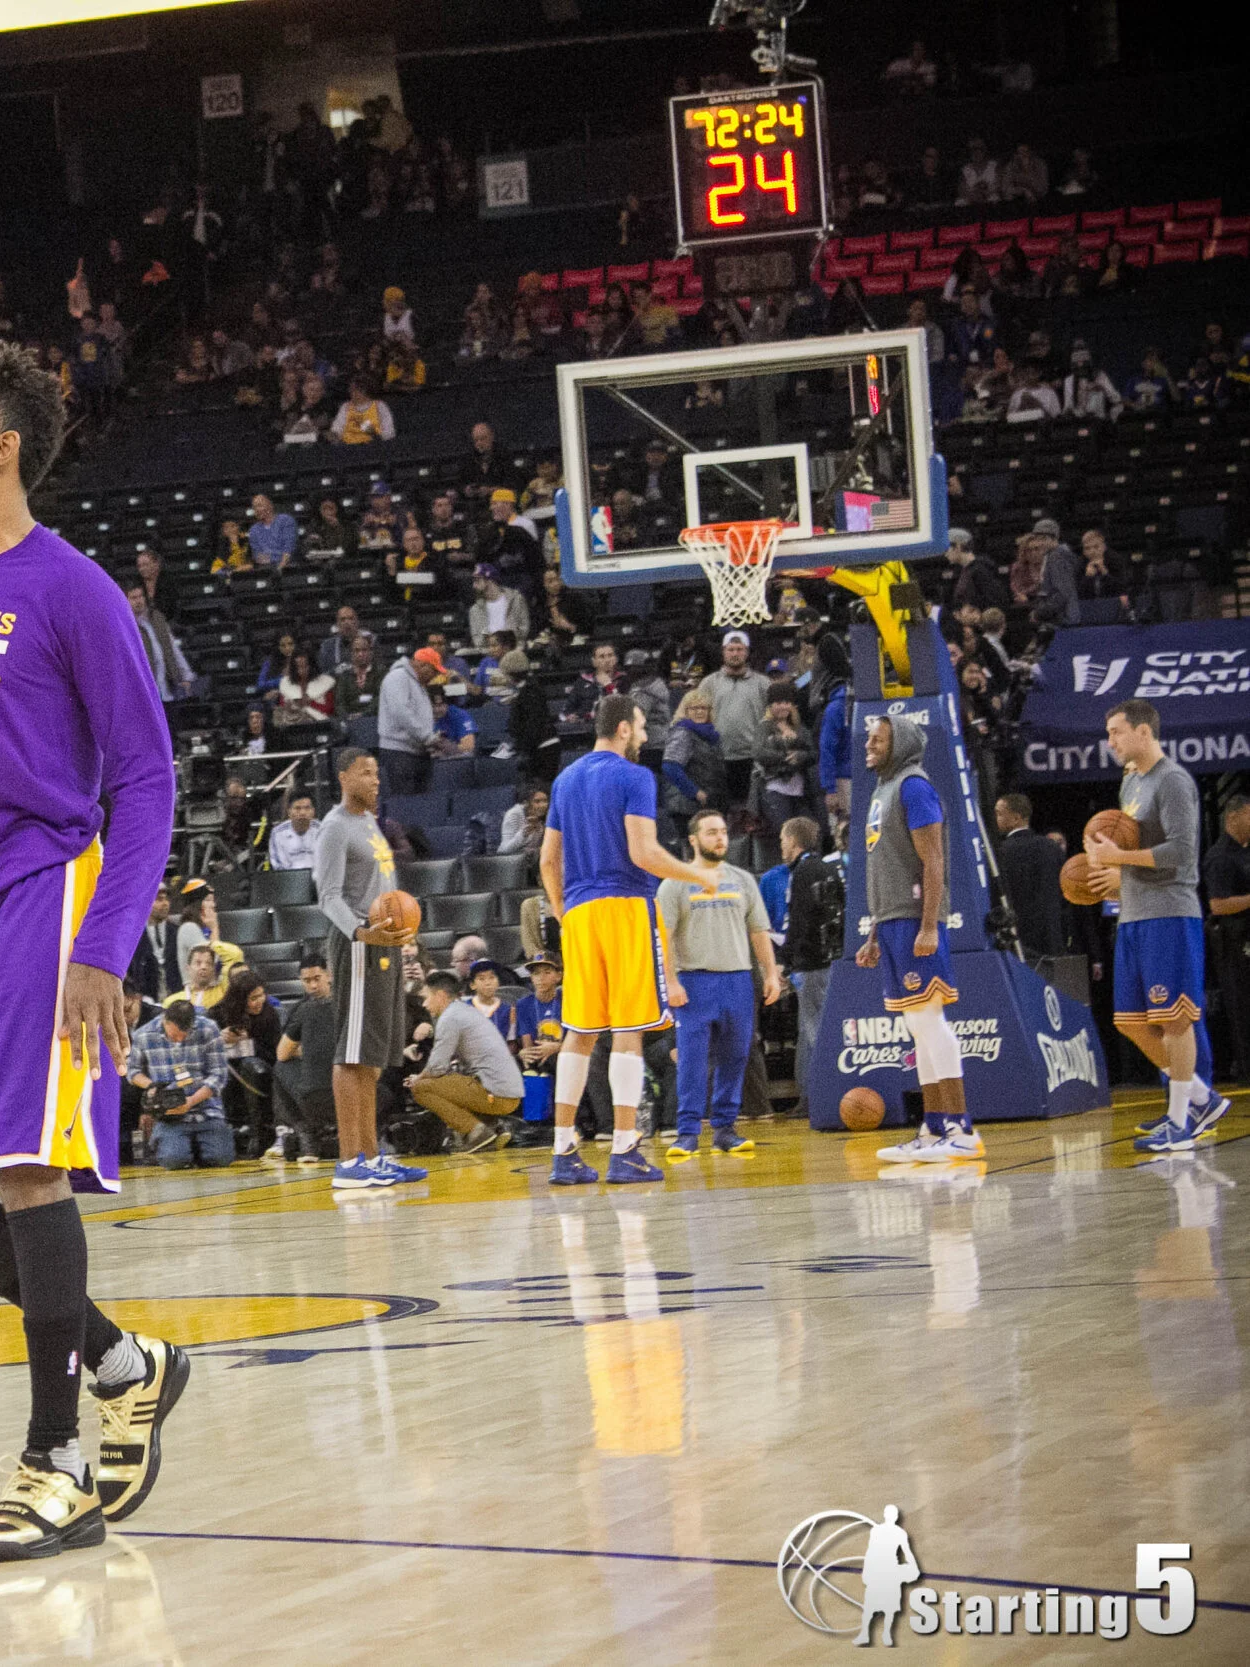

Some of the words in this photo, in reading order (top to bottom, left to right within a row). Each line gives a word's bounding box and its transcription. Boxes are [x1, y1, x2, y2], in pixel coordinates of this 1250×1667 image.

[207, 92, 240, 112] 120
[693, 103, 804, 148] 72:24
[492, 179, 525, 200] 121
[707, 151, 797, 225] 24
[1145, 649, 1248, 667] CITY
[1098, 734, 1250, 769] NIONA
[857, 1016, 911, 1045] NBA
[947, 1018, 999, 1036] ason
[838, 1046, 903, 1075] Cares
[958, 1036, 1002, 1062] ving
